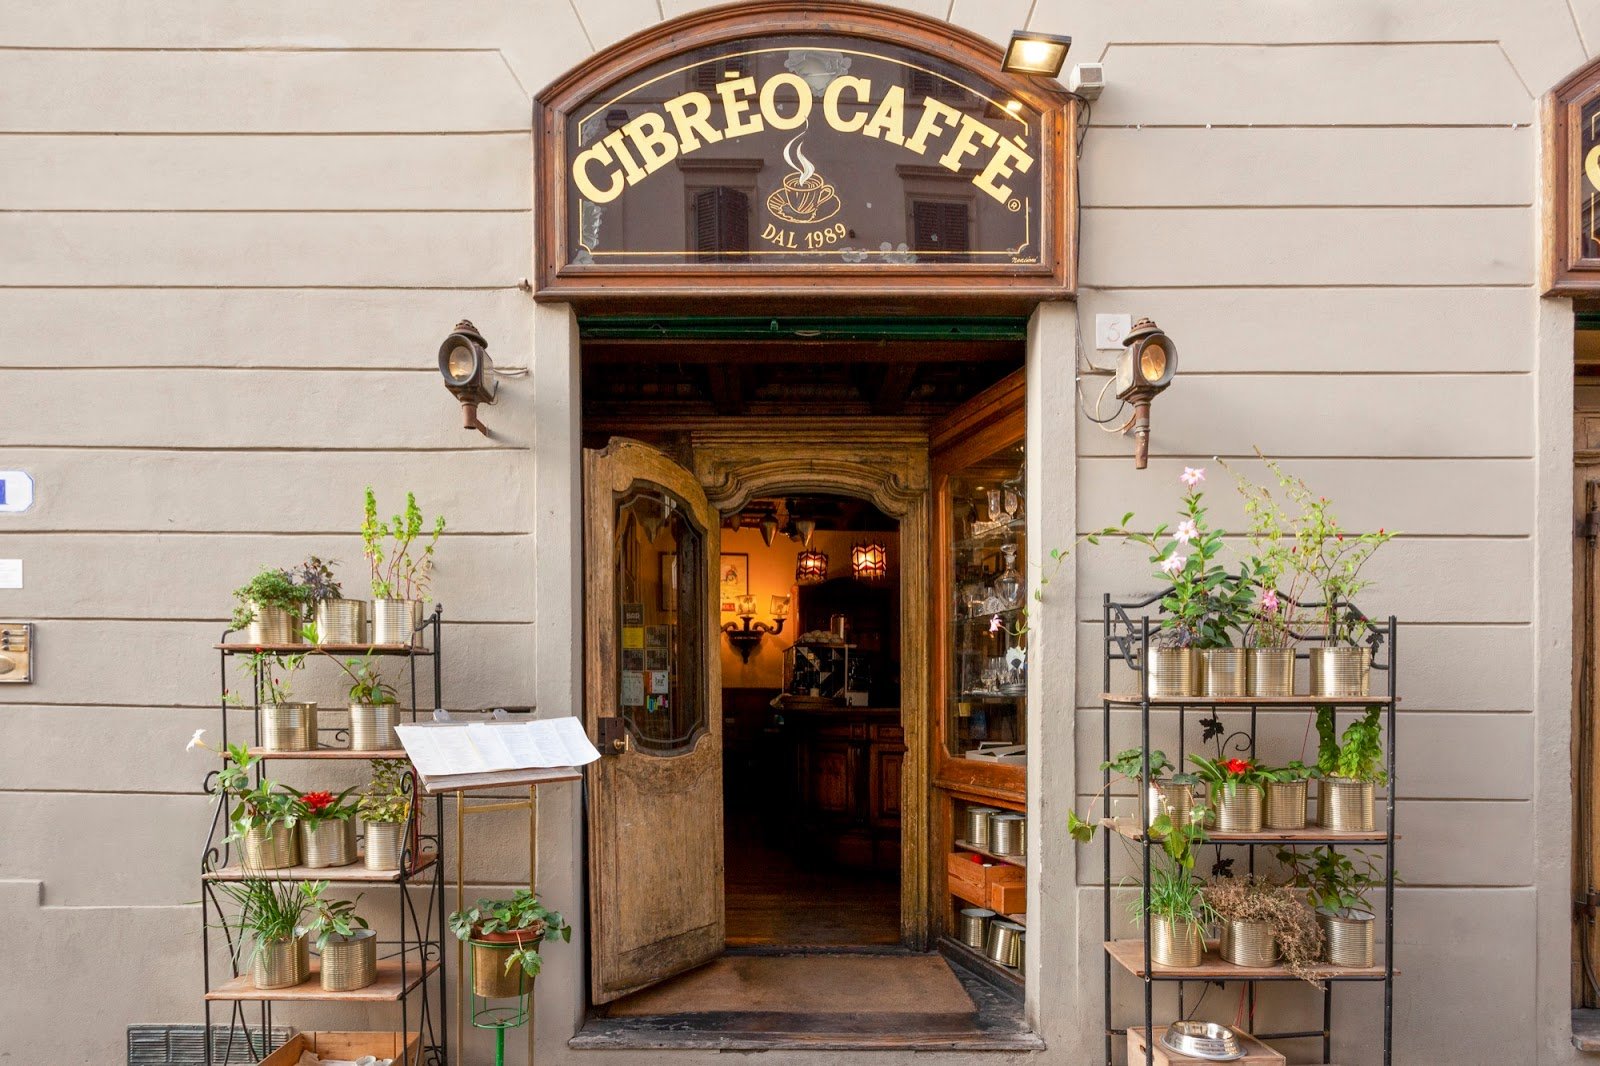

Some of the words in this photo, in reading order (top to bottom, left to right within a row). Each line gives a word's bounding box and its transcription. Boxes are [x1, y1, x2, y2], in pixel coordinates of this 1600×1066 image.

[822, 76, 1035, 204] CAFFÈ
[760, 223, 798, 249] DAL
[804, 222, 846, 249] 1989
